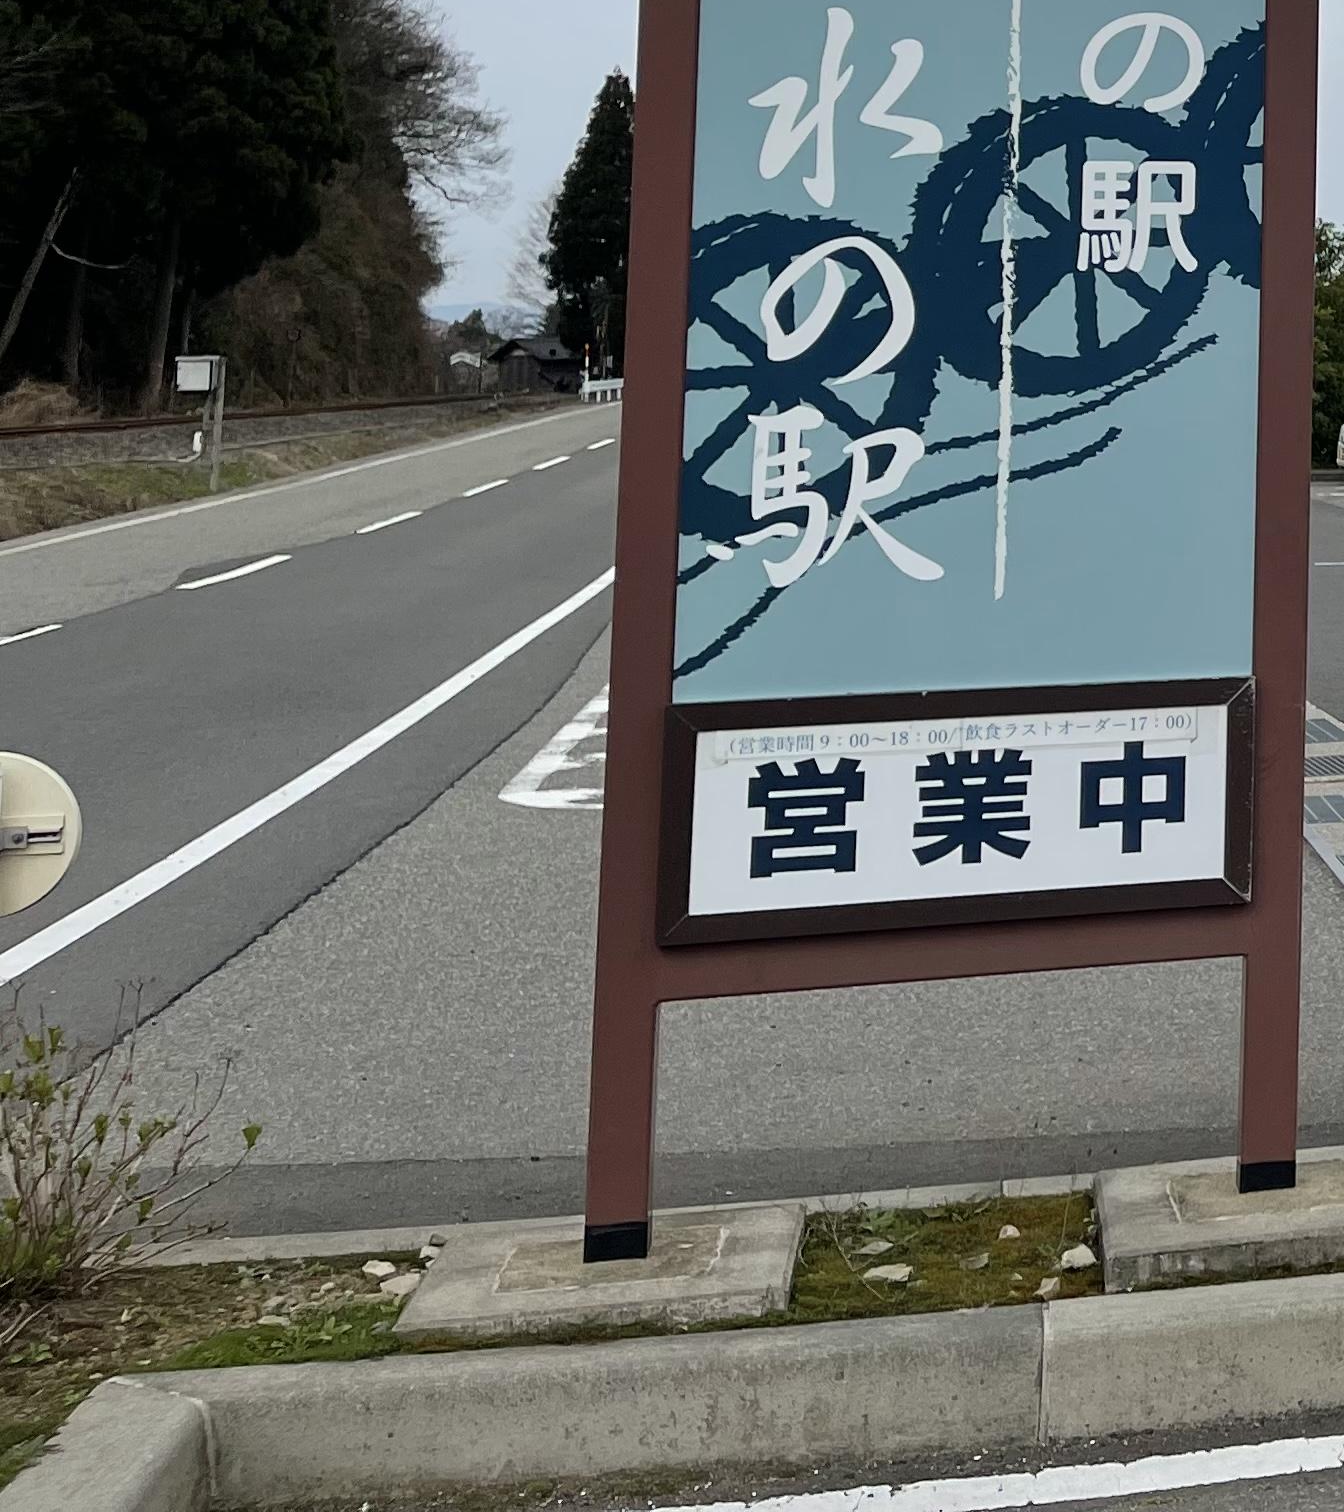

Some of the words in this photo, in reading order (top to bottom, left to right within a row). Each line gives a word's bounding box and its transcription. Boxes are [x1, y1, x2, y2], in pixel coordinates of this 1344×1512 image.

[706, 6, 946, 589] 水の駅
[747, 740, 1188, 879] 営業中
